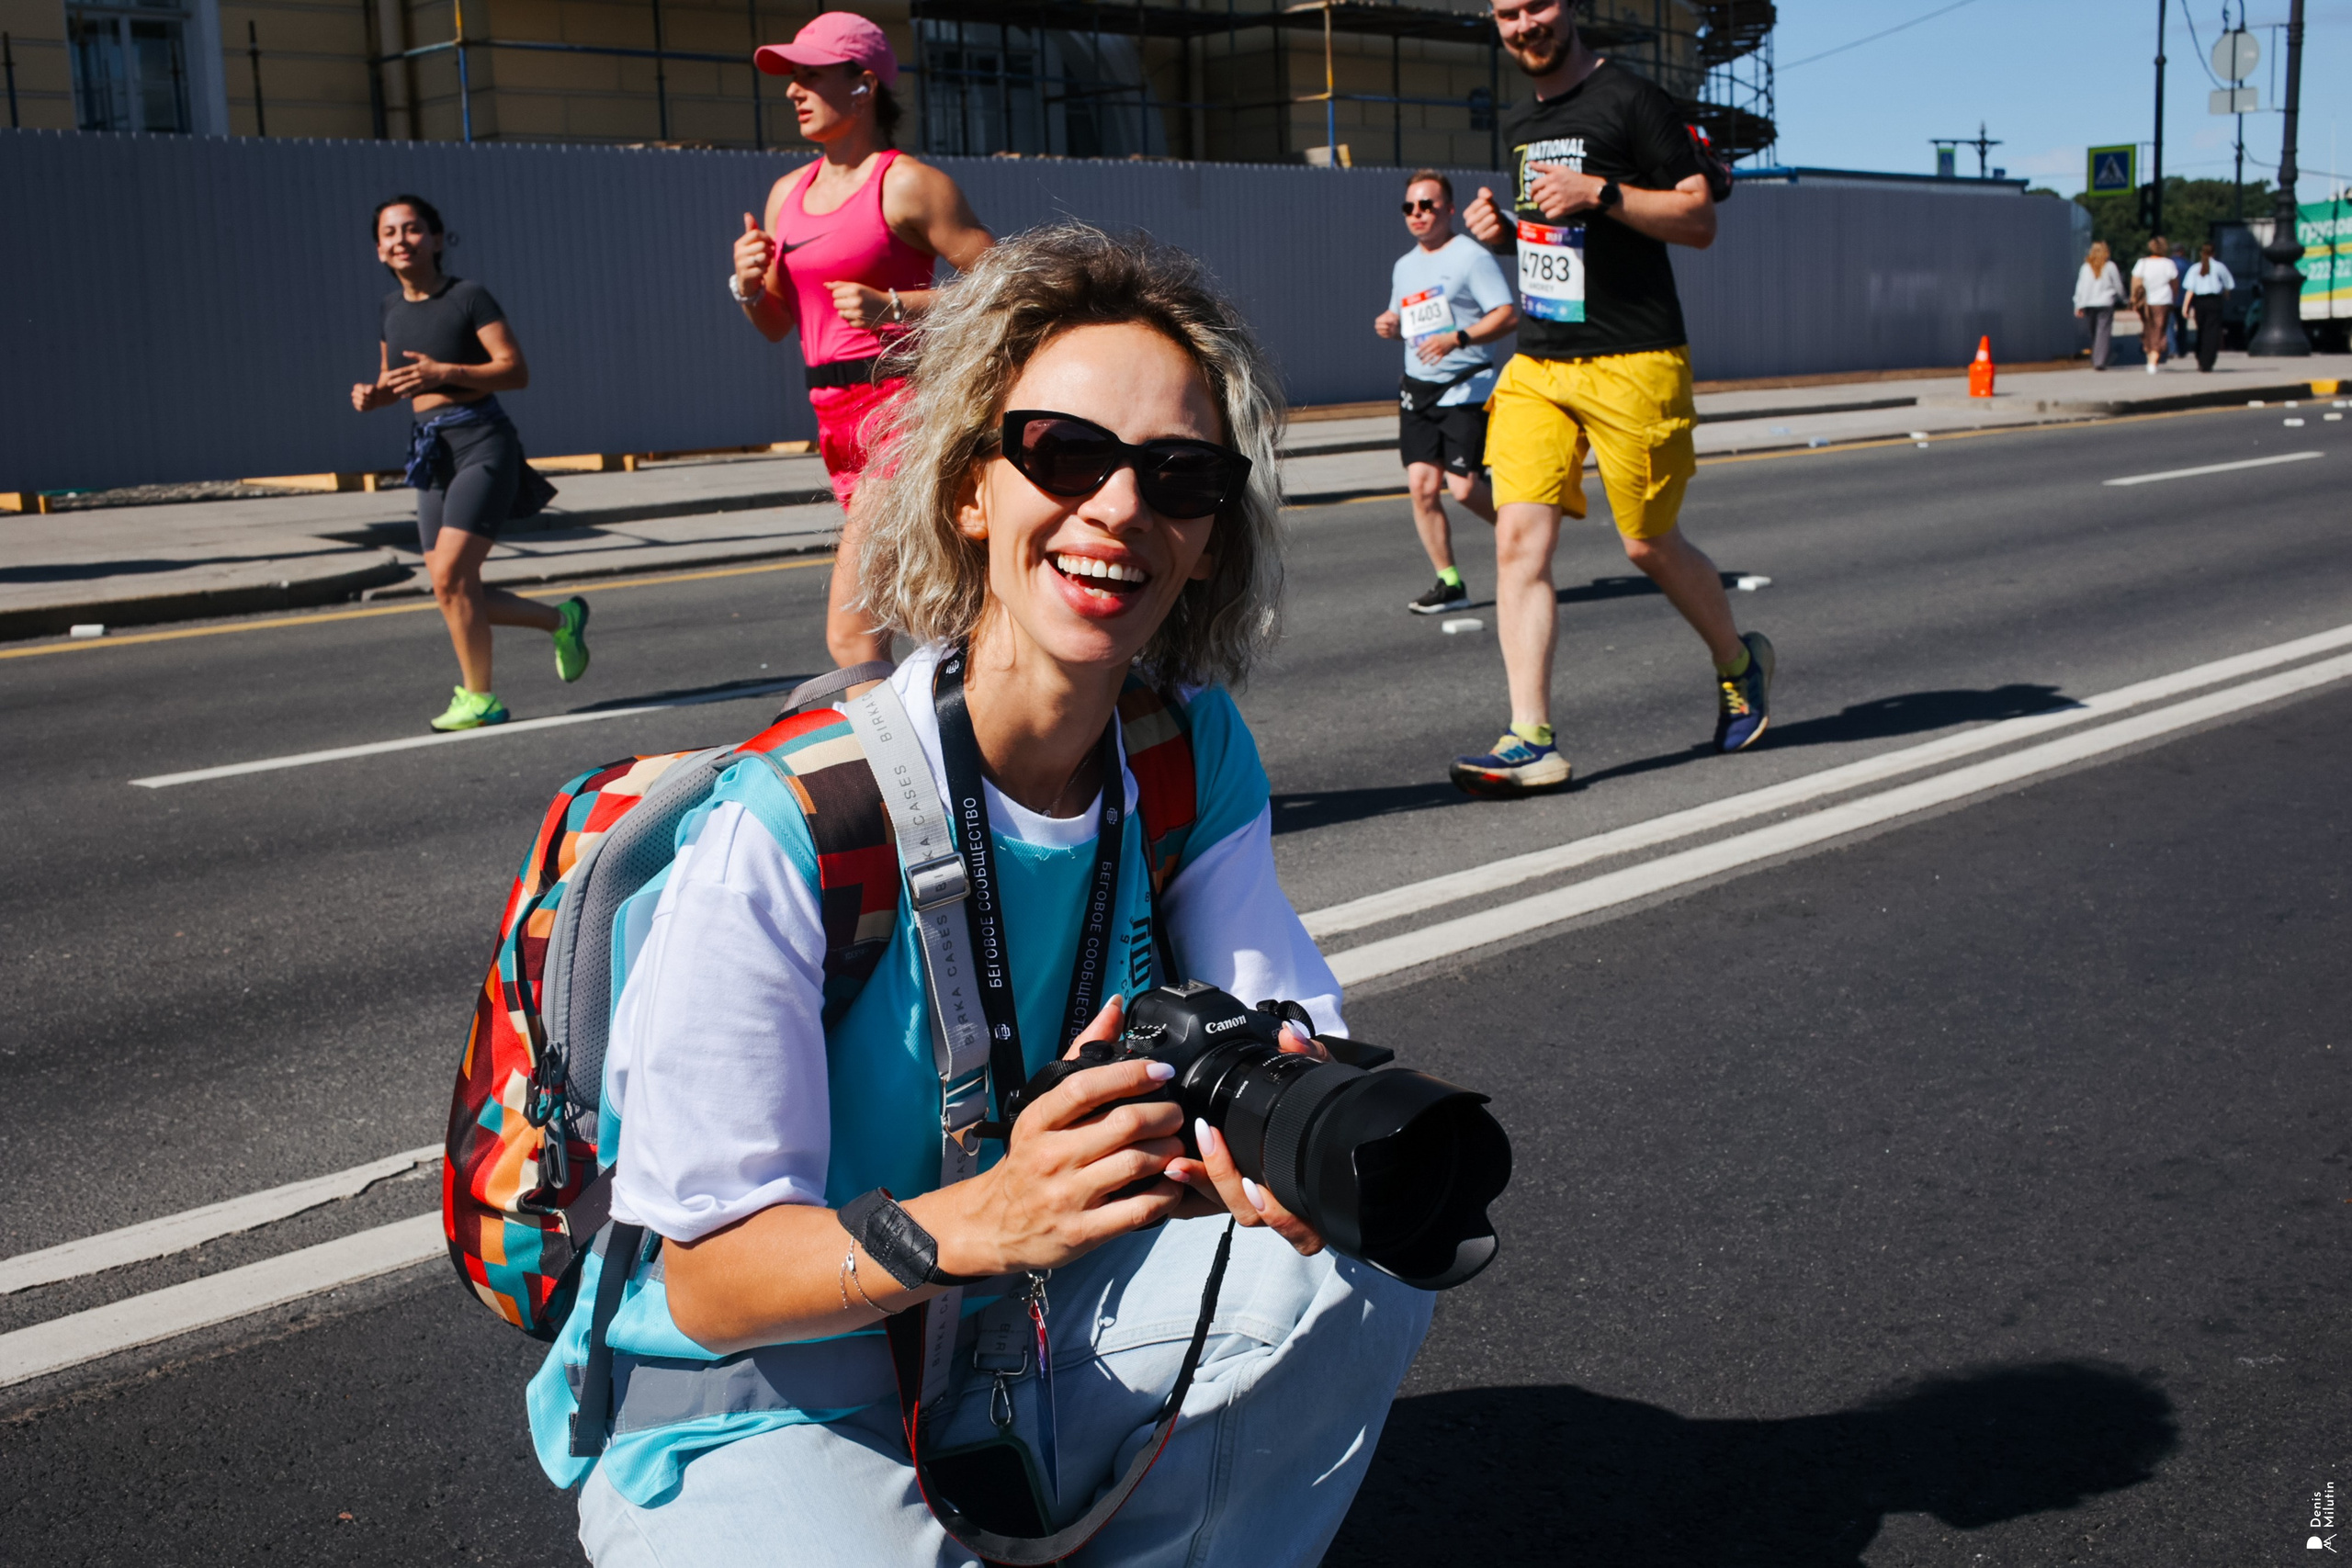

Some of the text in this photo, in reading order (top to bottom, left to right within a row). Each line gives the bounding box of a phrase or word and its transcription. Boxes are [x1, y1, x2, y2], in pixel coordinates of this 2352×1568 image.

[1526, 138, 1587, 162] NATIONAL
[1409, 302, 1442, 325] 1403
[865, 702, 894, 743] BIRKA
[894, 764, 926, 827] CASES
[963, 797, 1003, 989] БЕГОВОЕ СООБЩЕСТВО
[1090, 861, 1113, 933] БЕГОВОЕ
[936, 914, 976, 1046] BIRKA CASES
[1204, 1014, 1247, 1034] Canon
[1235, 1079, 1250, 1100] SIGMA
[995, 1323, 1011, 1351] BIR
